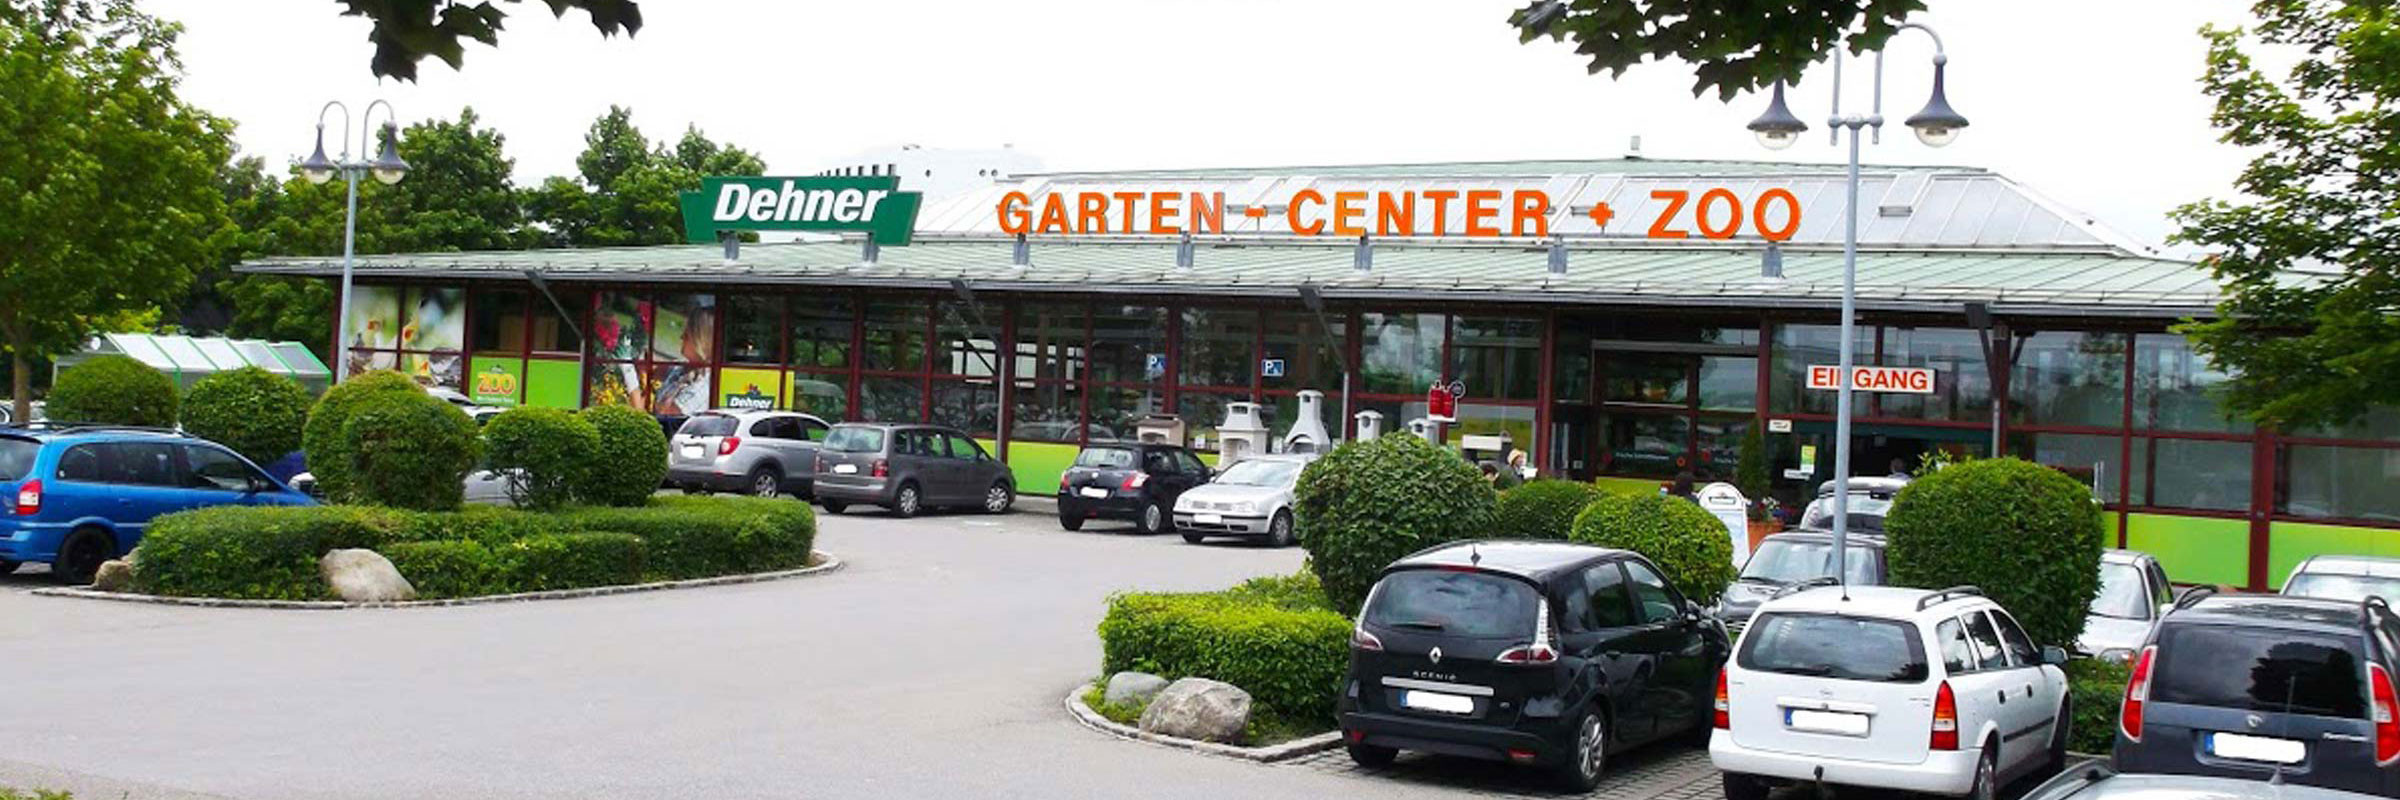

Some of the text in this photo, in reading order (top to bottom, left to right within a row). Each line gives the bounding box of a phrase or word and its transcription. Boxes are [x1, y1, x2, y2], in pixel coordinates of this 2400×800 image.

[713, 180, 888, 222] Dehner
[996, 191, 1225, 235] GARTEN
[1287, 188, 1550, 237] CENTER
[1648, 188, 1801, 241] ZOO
[1812, 367, 1928, 390] EIGANG
[729, 395, 772, 409] Dehner
